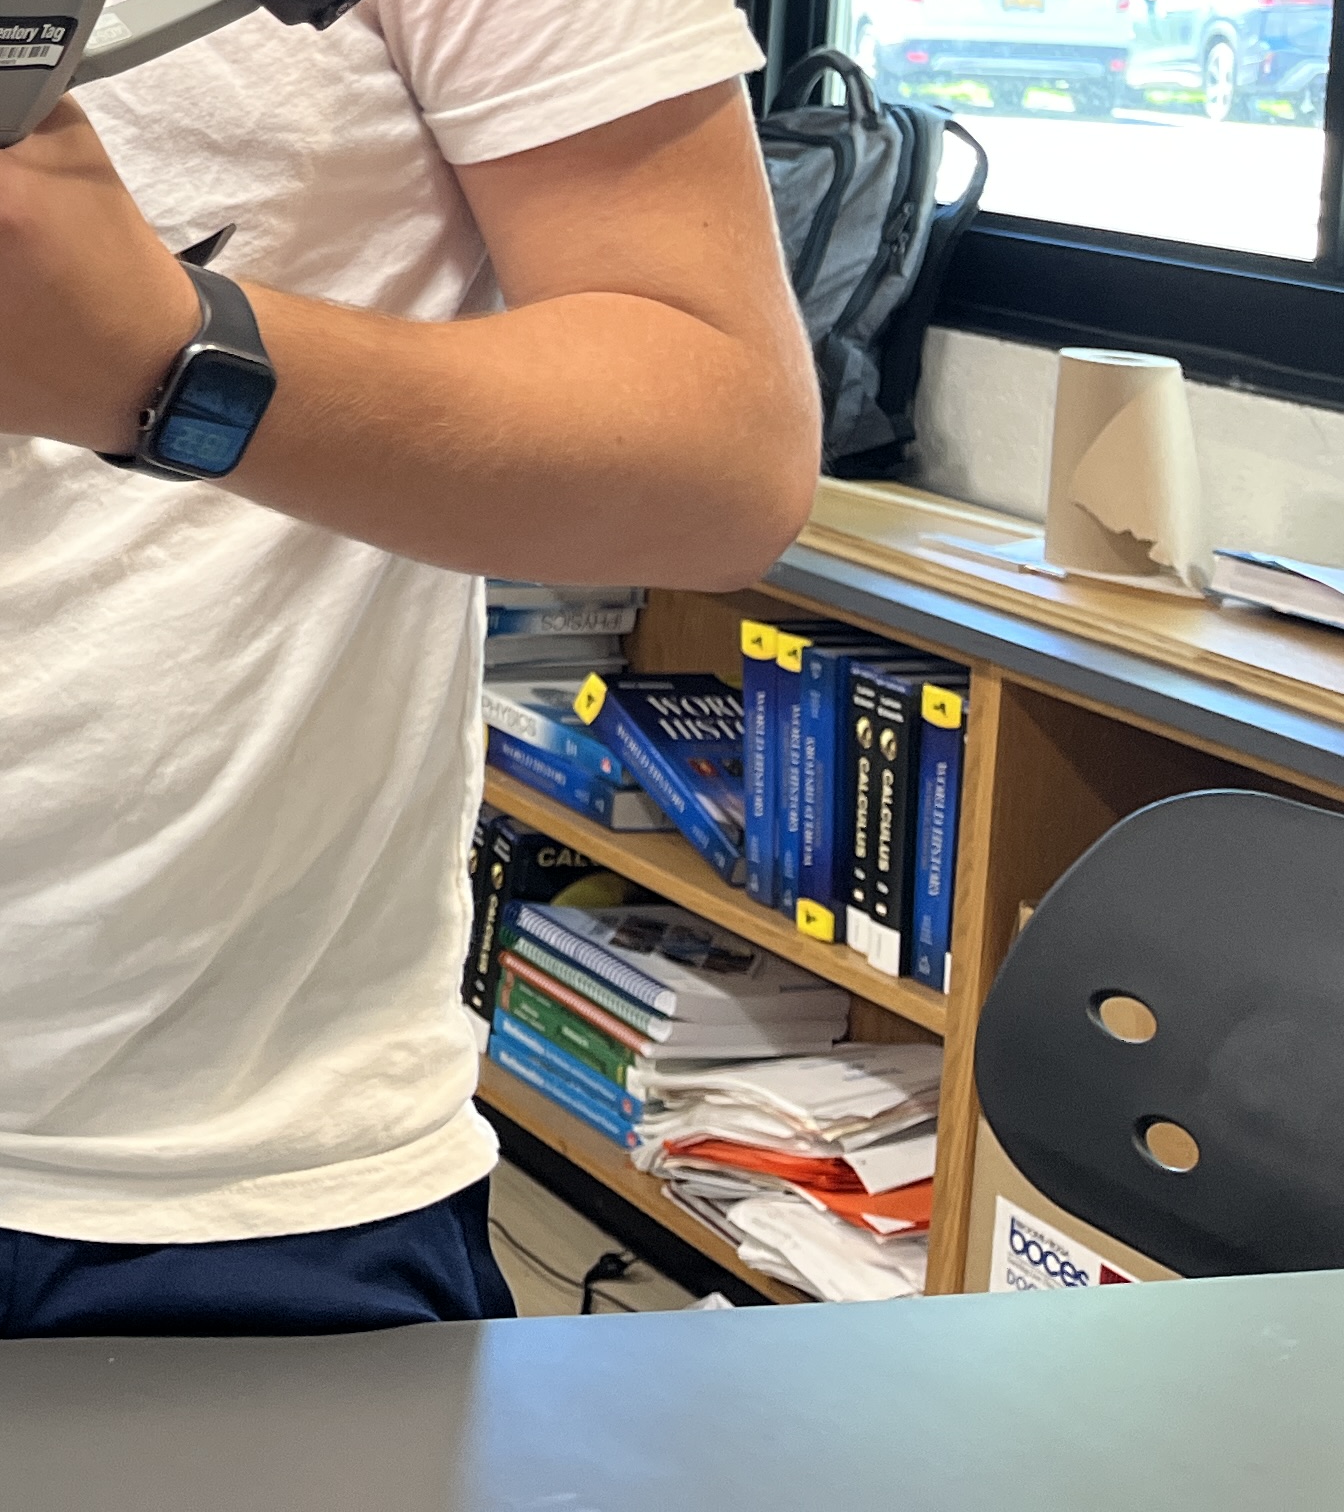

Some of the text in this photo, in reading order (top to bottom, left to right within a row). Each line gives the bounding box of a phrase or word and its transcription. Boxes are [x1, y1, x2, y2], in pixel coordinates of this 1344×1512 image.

[40, 23, 66, 43] Tag
[854, 755, 871, 859] CALCULUS
[877, 768, 895, 873] CALCULUS
[932, 761, 948, 826] WORLD
[536, 846, 603, 868] CAL
[1009, 1216, 1090, 1287] boces
